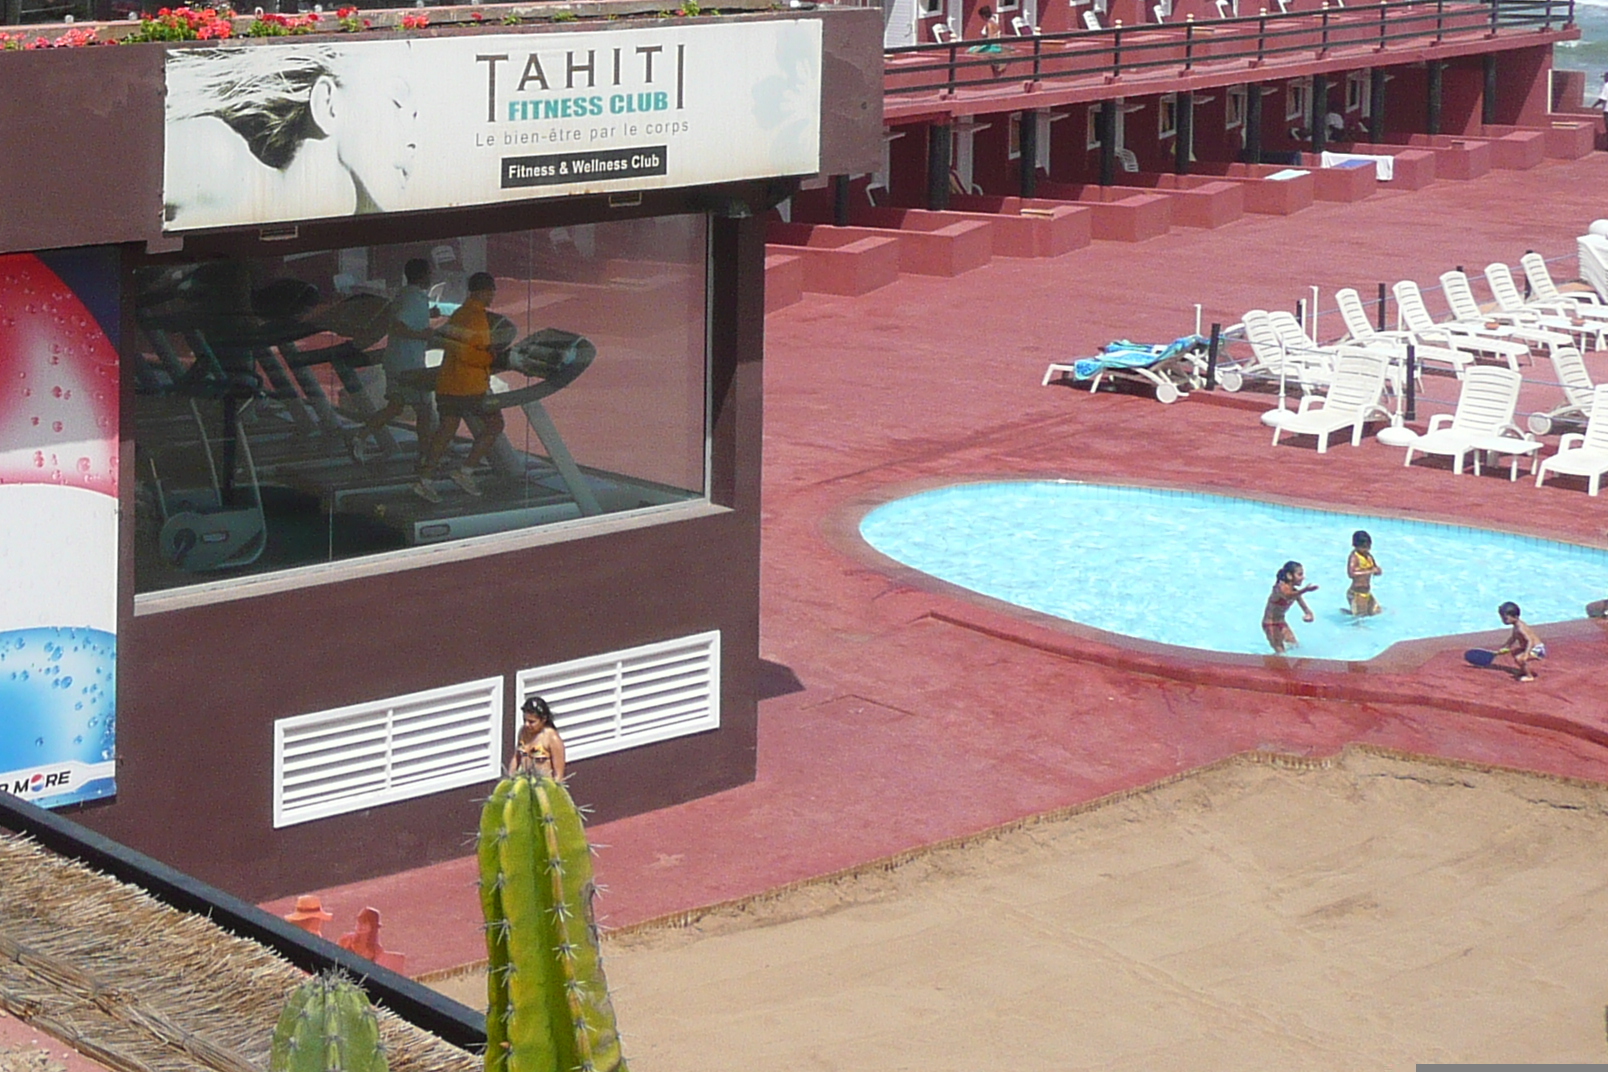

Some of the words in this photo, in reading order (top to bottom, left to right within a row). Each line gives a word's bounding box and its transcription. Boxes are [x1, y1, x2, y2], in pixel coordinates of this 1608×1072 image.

[476, 44, 684, 122] TAHITI
[508, 95, 603, 121] FITNESS
[609, 91, 668, 115] CLUB
[476, 132, 495, 147] Le
[504, 128, 582, 145] bien-être
[590, 127, 616, 142] par
[624, 123, 638, 136] le
[646, 120, 690, 136] corps
[508, 163, 555, 179] Fitness
[559, 161, 569, 175] &
[572, 157, 628, 175] Wellness
[631, 153, 660, 169] Club
